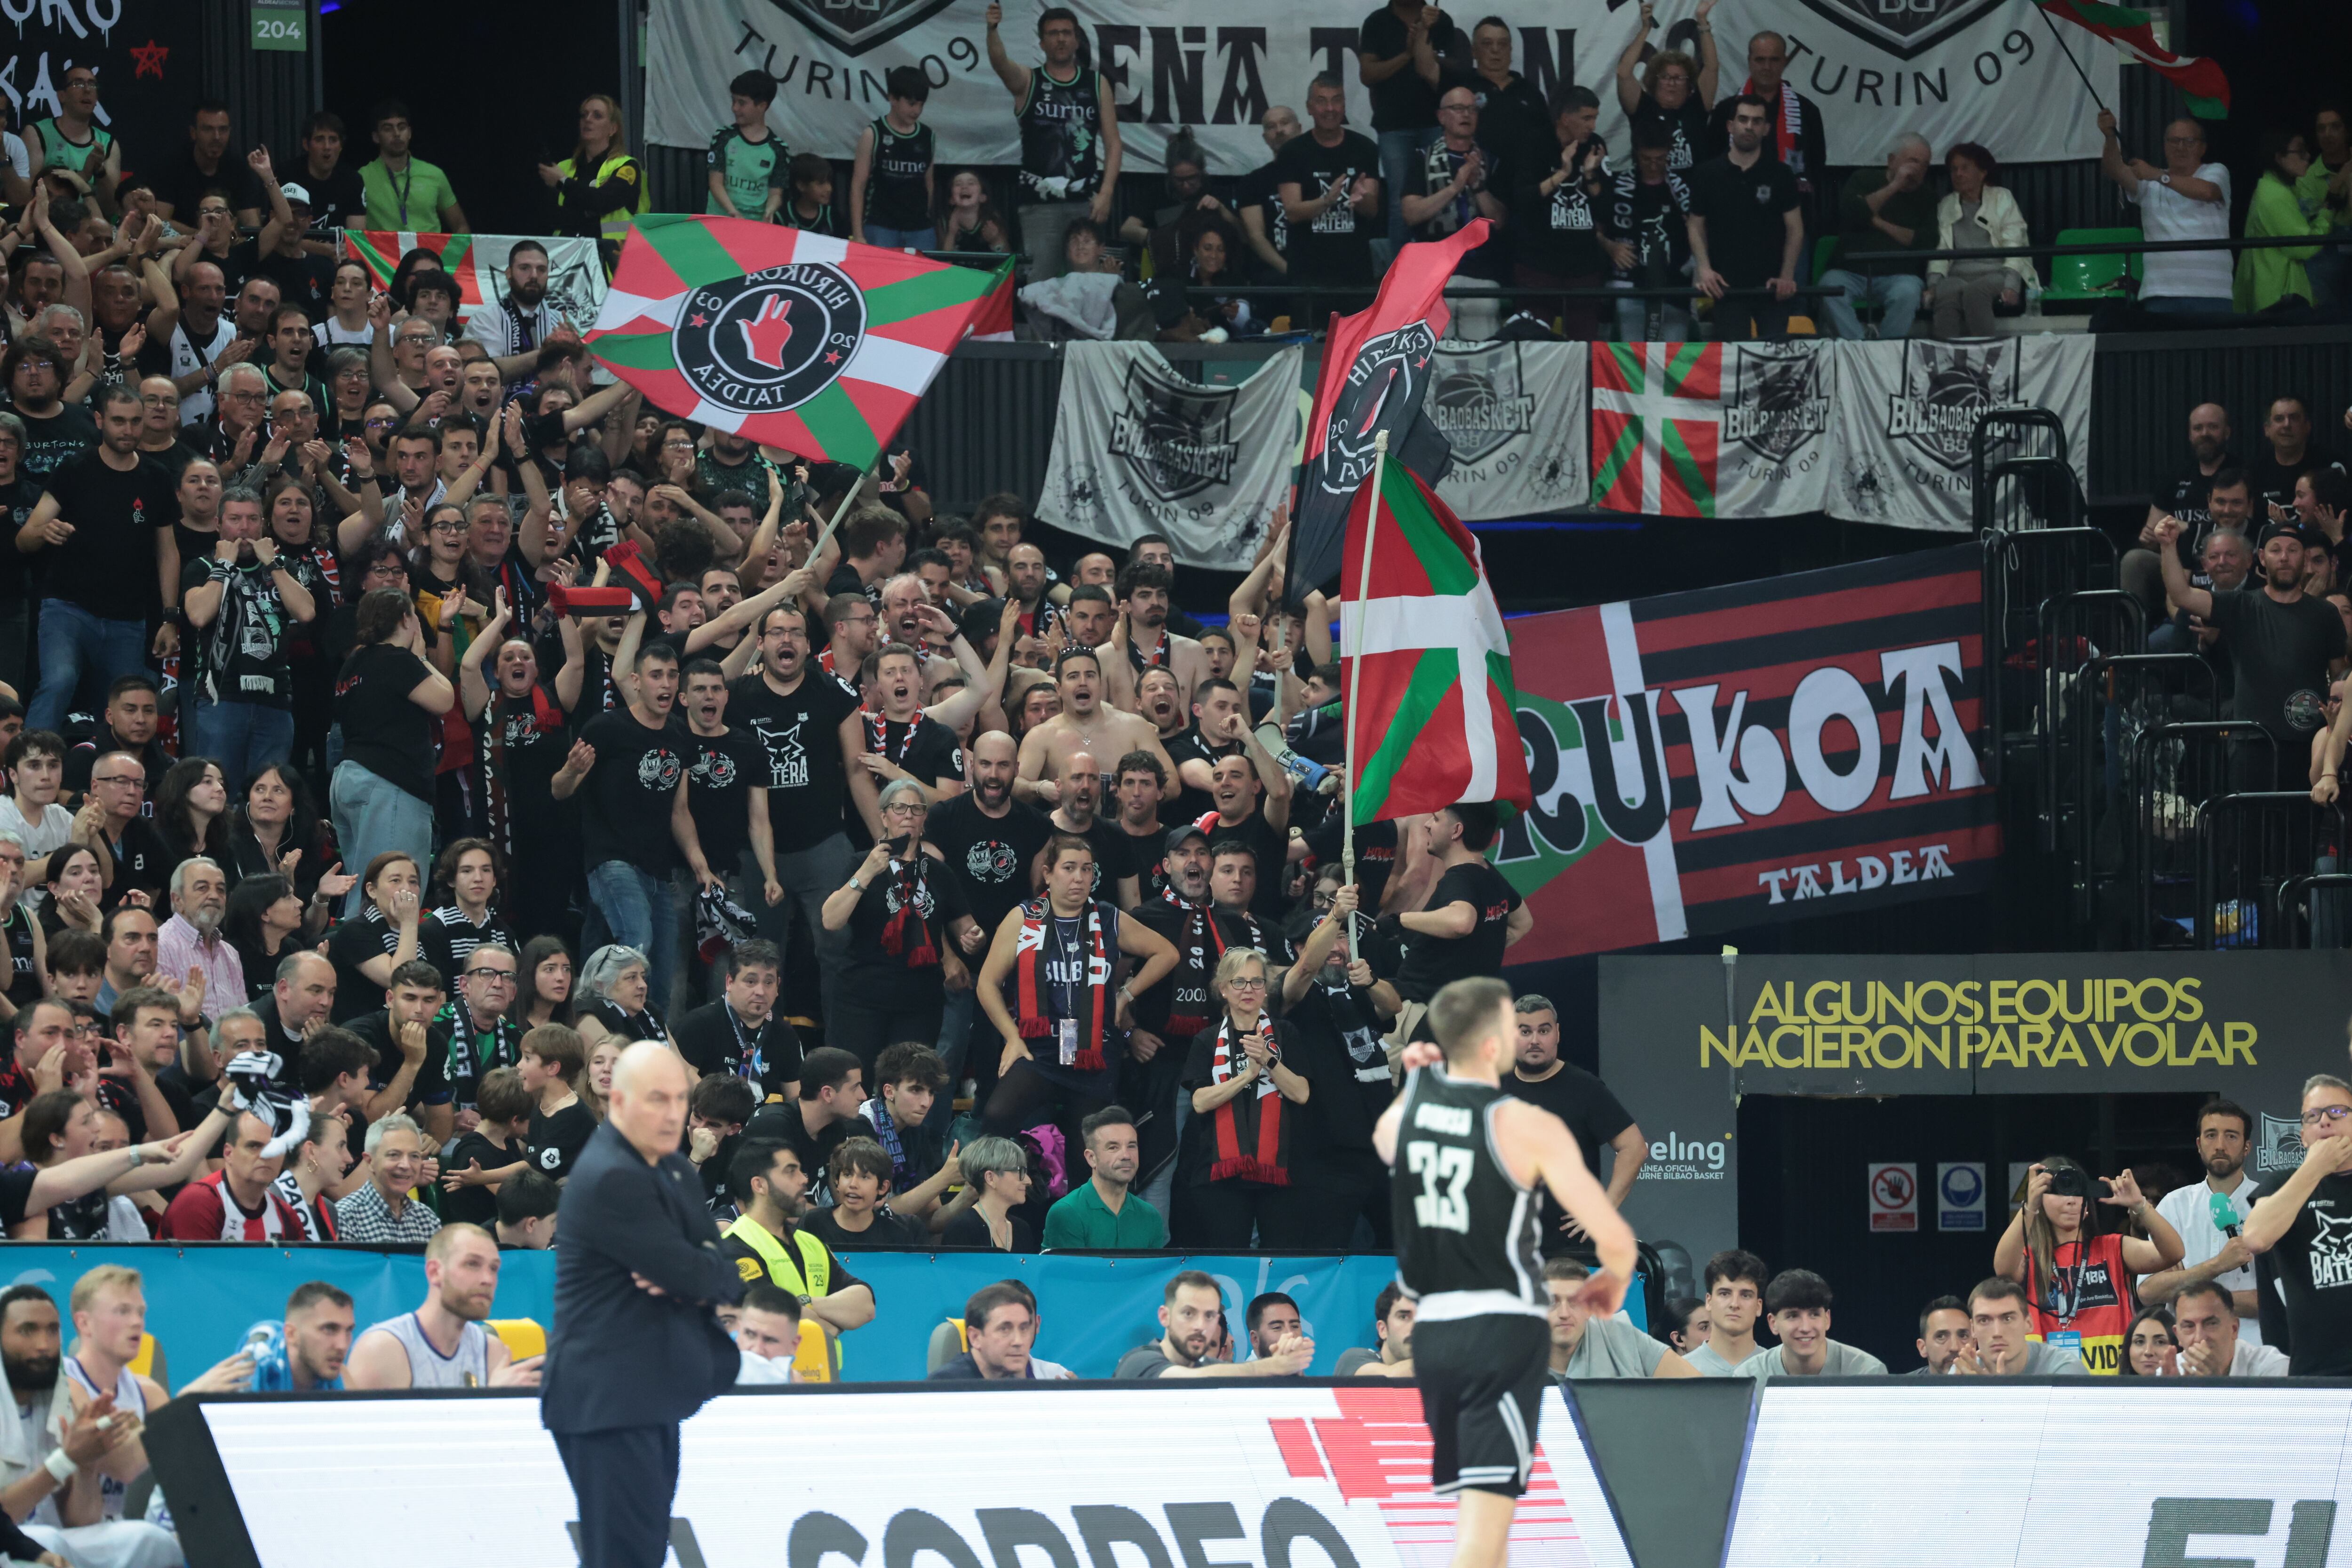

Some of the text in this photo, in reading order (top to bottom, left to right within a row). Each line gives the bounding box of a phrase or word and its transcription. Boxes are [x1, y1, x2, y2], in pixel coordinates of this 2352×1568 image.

[257, 20, 301, 39] 204
[734, 20, 980, 103] TURIN 09
[1785, 29, 2034, 106] TURIN 09
[1035, 101, 1095, 120] surne
[1550, 202, 1593, 227] BATERA
[1433, 399, 1534, 431] LBAOBASKET
[1447, 452, 1521, 484] RIN 09
[1738, 451, 1820, 482] TURIN 09
[1117, 478, 1215, 523] TURIN 09
[1494, 641, 1986, 863] RUKOA
[771, 756, 810, 785] TERA
[1759, 844, 1955, 905] TALDEA
[1176, 988, 1207, 1003] 2003
[1748, 977, 2203, 1033] ALGUNOS EQUIPOS
[1700, 1021, 2257, 1069] NACIERON PARA VOLAR
[1645, 1131, 1725, 1170] eling
[2260, 1150, 2308, 1167] BILBAOBAS
[814, 1275, 824, 1286] 29
[2084, 1269, 2107, 1285] IBA
[2309, 1249, 2352, 1287] BATE
